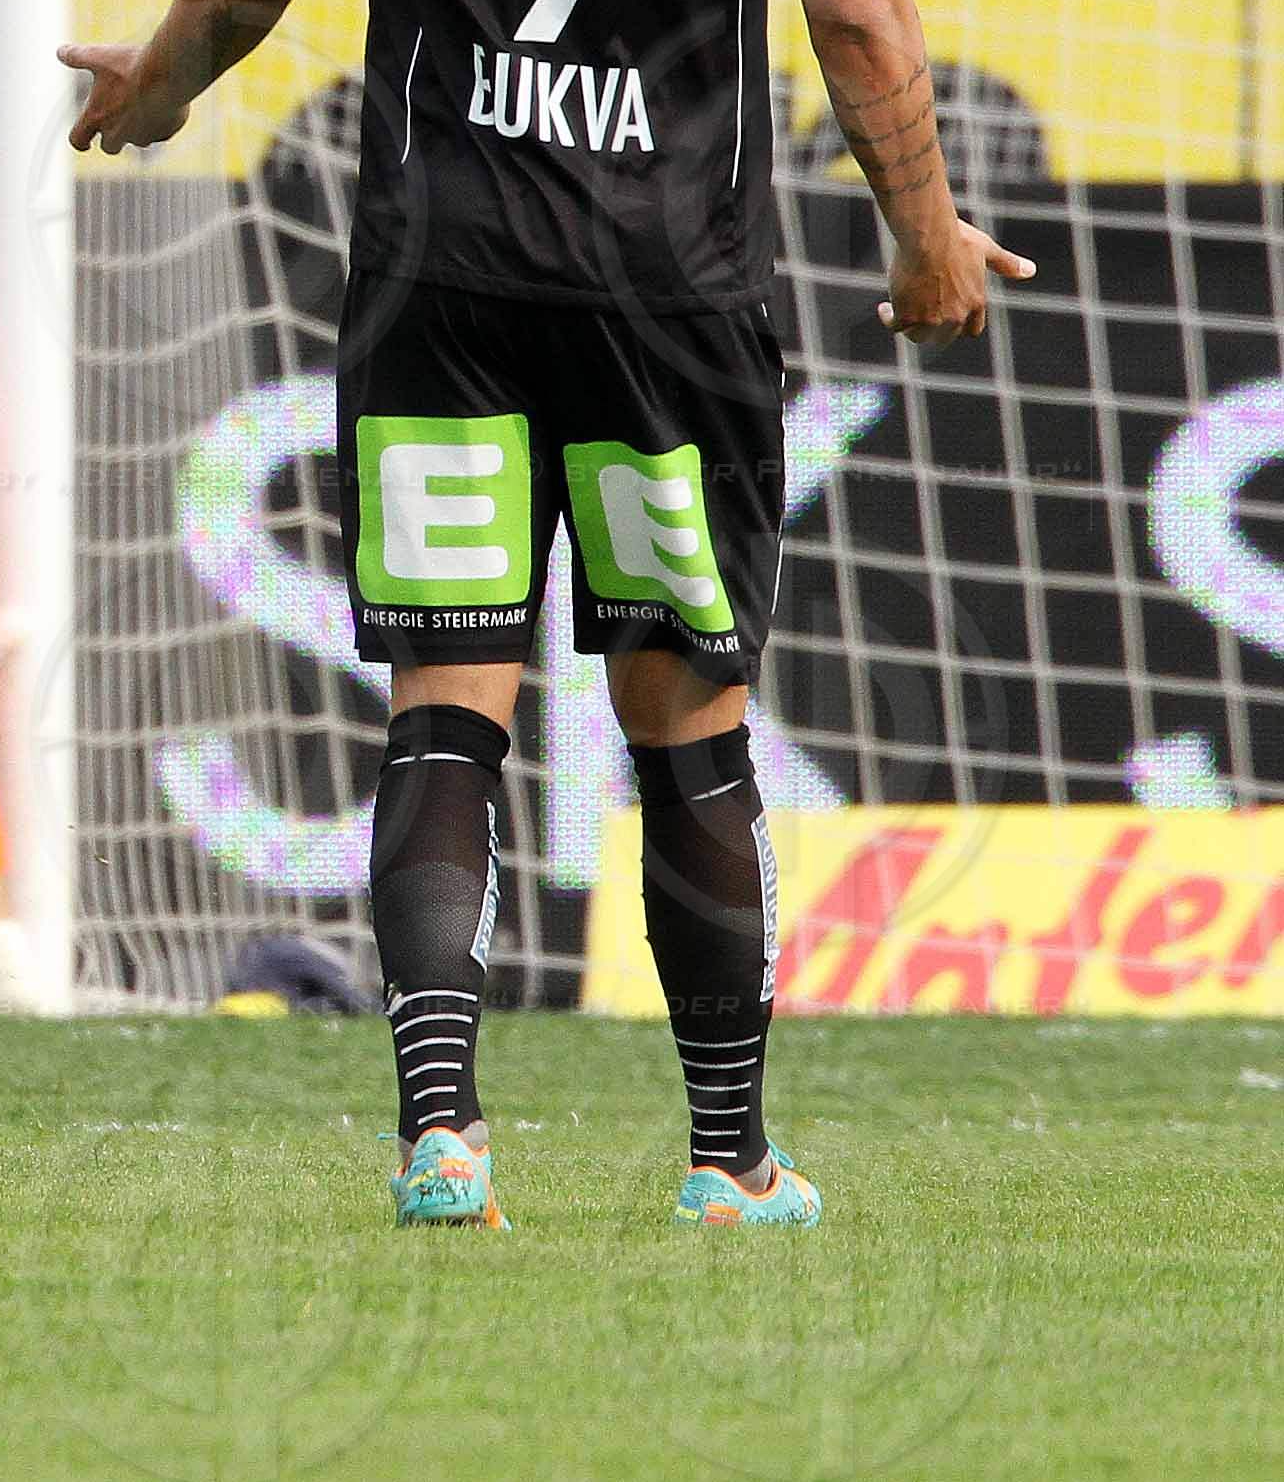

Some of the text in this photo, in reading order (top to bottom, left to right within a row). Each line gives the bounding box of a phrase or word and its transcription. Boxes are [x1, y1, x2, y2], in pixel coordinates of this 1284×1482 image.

[379, 444, 509, 579] E
[362, 606, 527, 630] ENERGIE STEIERMARK
[596, 603, 667, 623] ENERGIE
